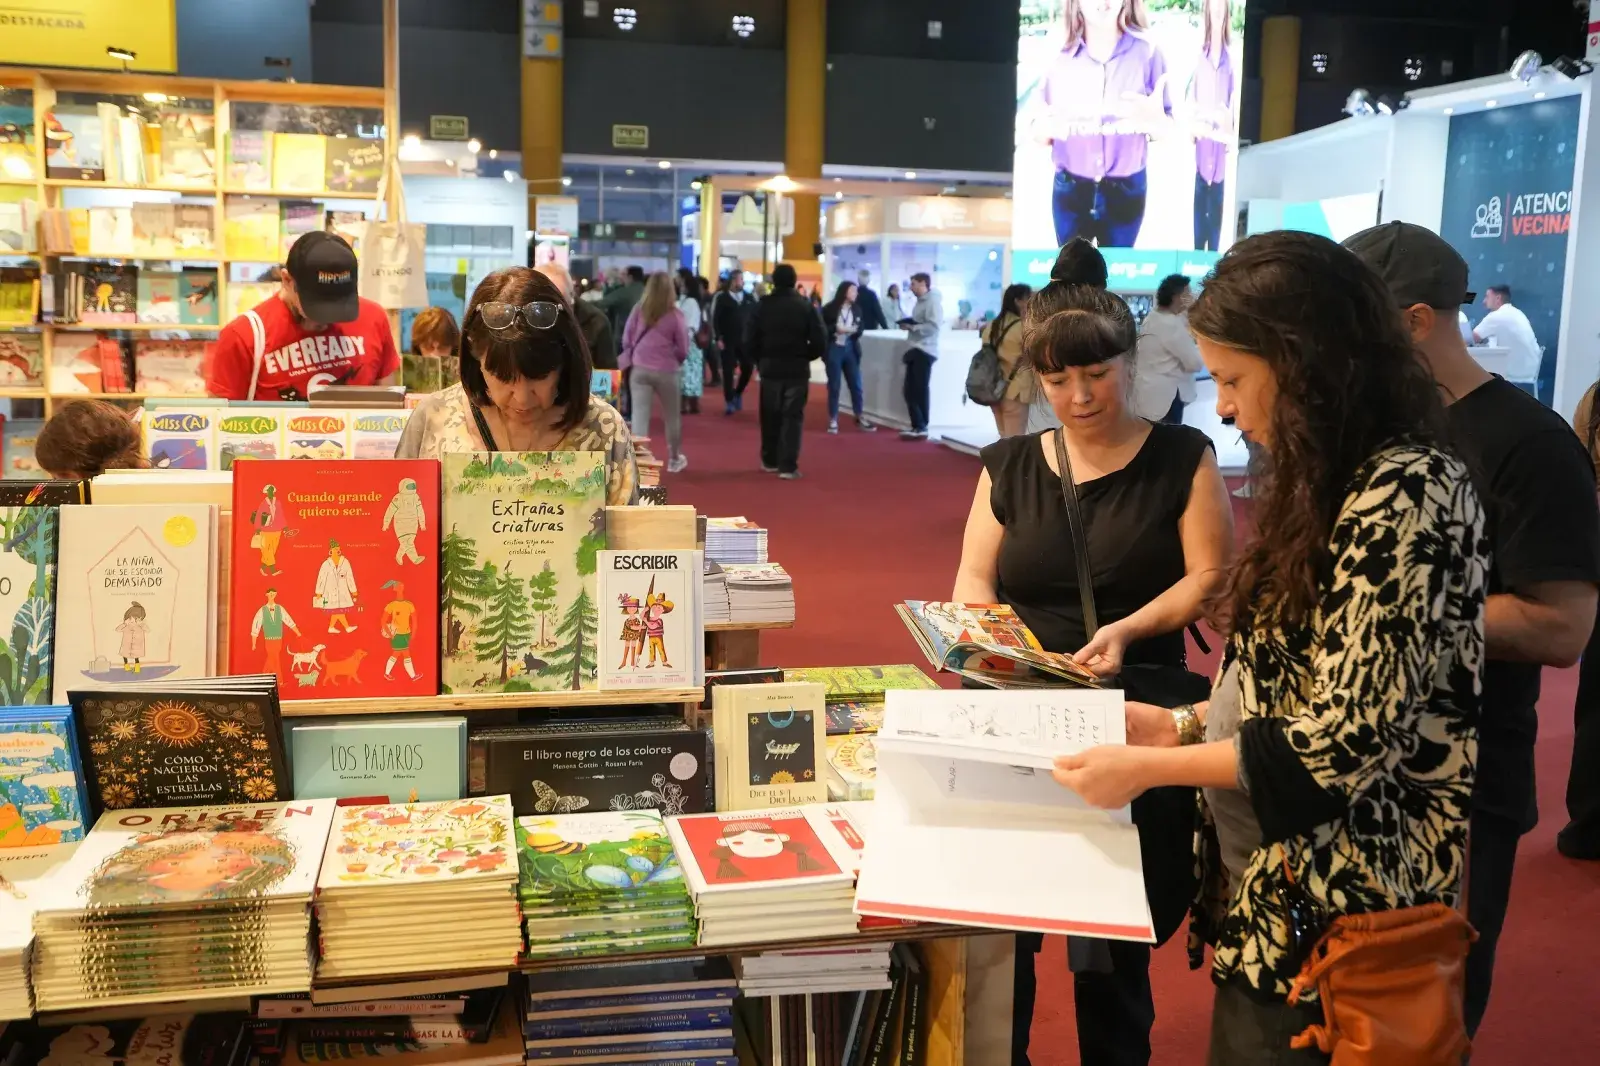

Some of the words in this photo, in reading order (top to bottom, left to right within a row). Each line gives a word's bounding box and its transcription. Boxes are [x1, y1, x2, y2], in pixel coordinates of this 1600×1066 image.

[0, 14, 86, 30] DESTACADA
[264, 335, 366, 375] EVEREADY
[288, 367, 307, 377] UNA
[334, 359, 352, 367] VIDA
[150, 417, 181, 431] MISS
[182, 415, 207, 432] CAT
[219, 419, 249, 432] MISS
[251, 416, 275, 434] CAT
[288, 419, 317, 431] MISS
[319, 417, 343, 434] CAT
[354, 419, 381, 431] MISS
[383, 416, 408, 433] CAT
[287, 491, 335, 503] Cuando
[338, 490, 382, 505] grande
[298, 506, 340, 520] quiero
[343, 507, 371, 516] ser...
[492, 499, 565, 516] Extrañas
[492, 517, 564, 533] Criaturas
[117, 557, 128, 567] LA
[131, 555, 154, 566] NIÑA
[613, 555, 678, 570] ESCRIBIR
[119, 568, 128, 576] SE
[104, 576, 163, 588] DEMASIADO
[164, 755, 204, 765] CÓMO
[331, 745, 356, 771] LOS
[364, 743, 423, 771] PÁJAROS
[523, 750, 533, 761] El
[536, 749, 562, 760] libro
[565, 750, 597, 761] negro
[600, 747, 613, 757] de
[616, 746, 631, 756] los
[633, 745, 672, 756] colores
[153, 764, 218, 775] NACIERON
[177, 774, 199, 783] LAS
[156, 782, 222, 795] ESTRELLAS
[749, 789, 767, 799] DICE
[118, 806, 314, 827] ORIGEN
[441, 1028, 453, 1038] LA
